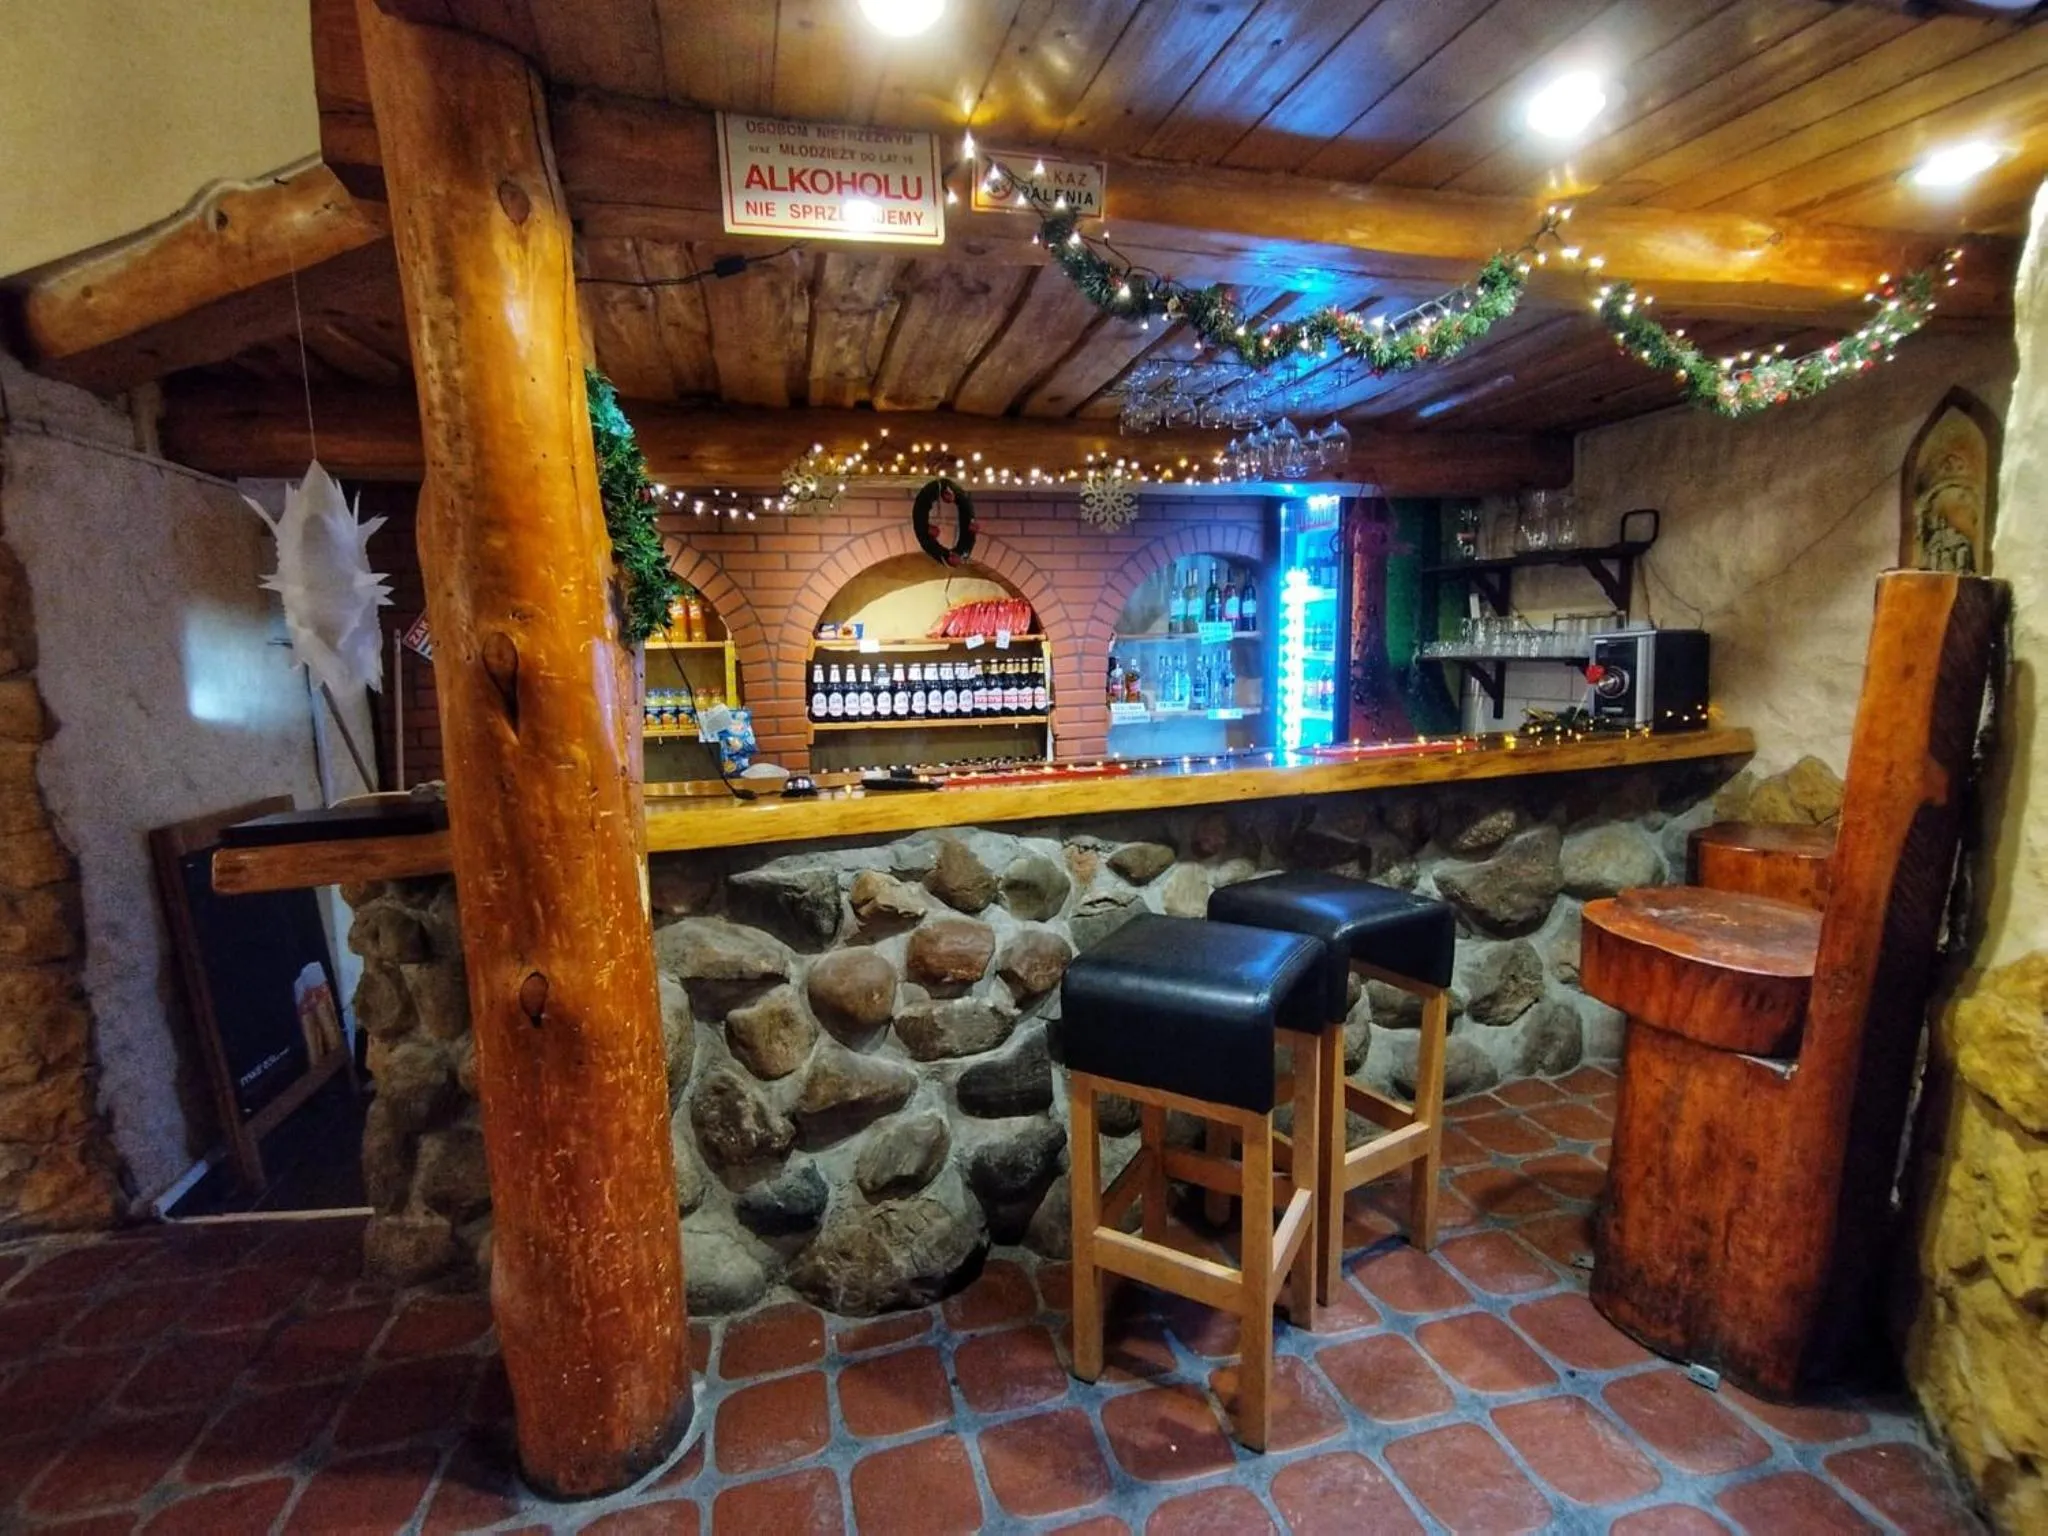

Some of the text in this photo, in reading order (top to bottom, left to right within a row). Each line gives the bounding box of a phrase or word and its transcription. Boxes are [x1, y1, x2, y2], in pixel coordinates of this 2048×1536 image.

[746, 120, 808, 138] OSOBOM
[861, 152, 876, 163] DO
[744, 164, 923, 201] ALKOHOLU
[745, 201, 924, 226] NIE SPRZJEMY
